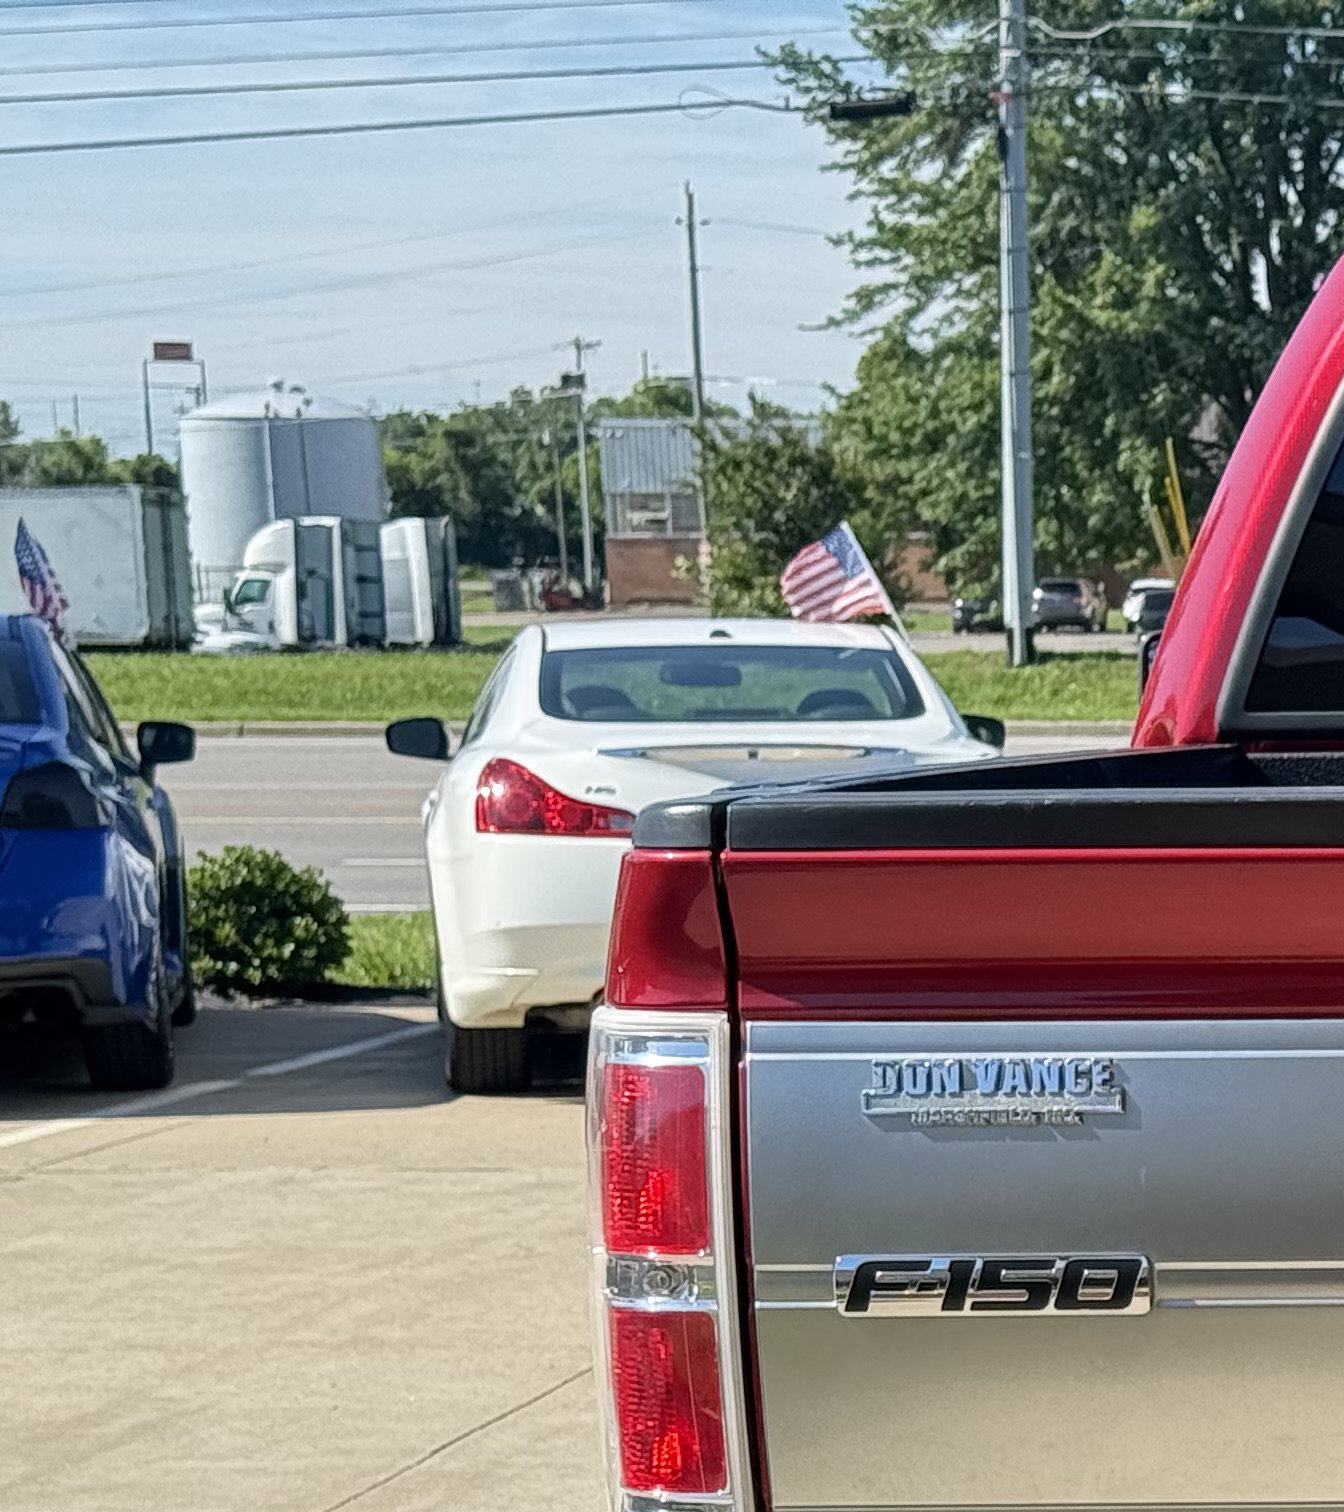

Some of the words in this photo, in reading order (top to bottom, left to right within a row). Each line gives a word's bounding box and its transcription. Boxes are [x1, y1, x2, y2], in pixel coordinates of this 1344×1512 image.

[871, 1058, 962, 1096] DON
[972, 1057, 1116, 1096] VANCE
[843, 1257, 1147, 1313] F-150
